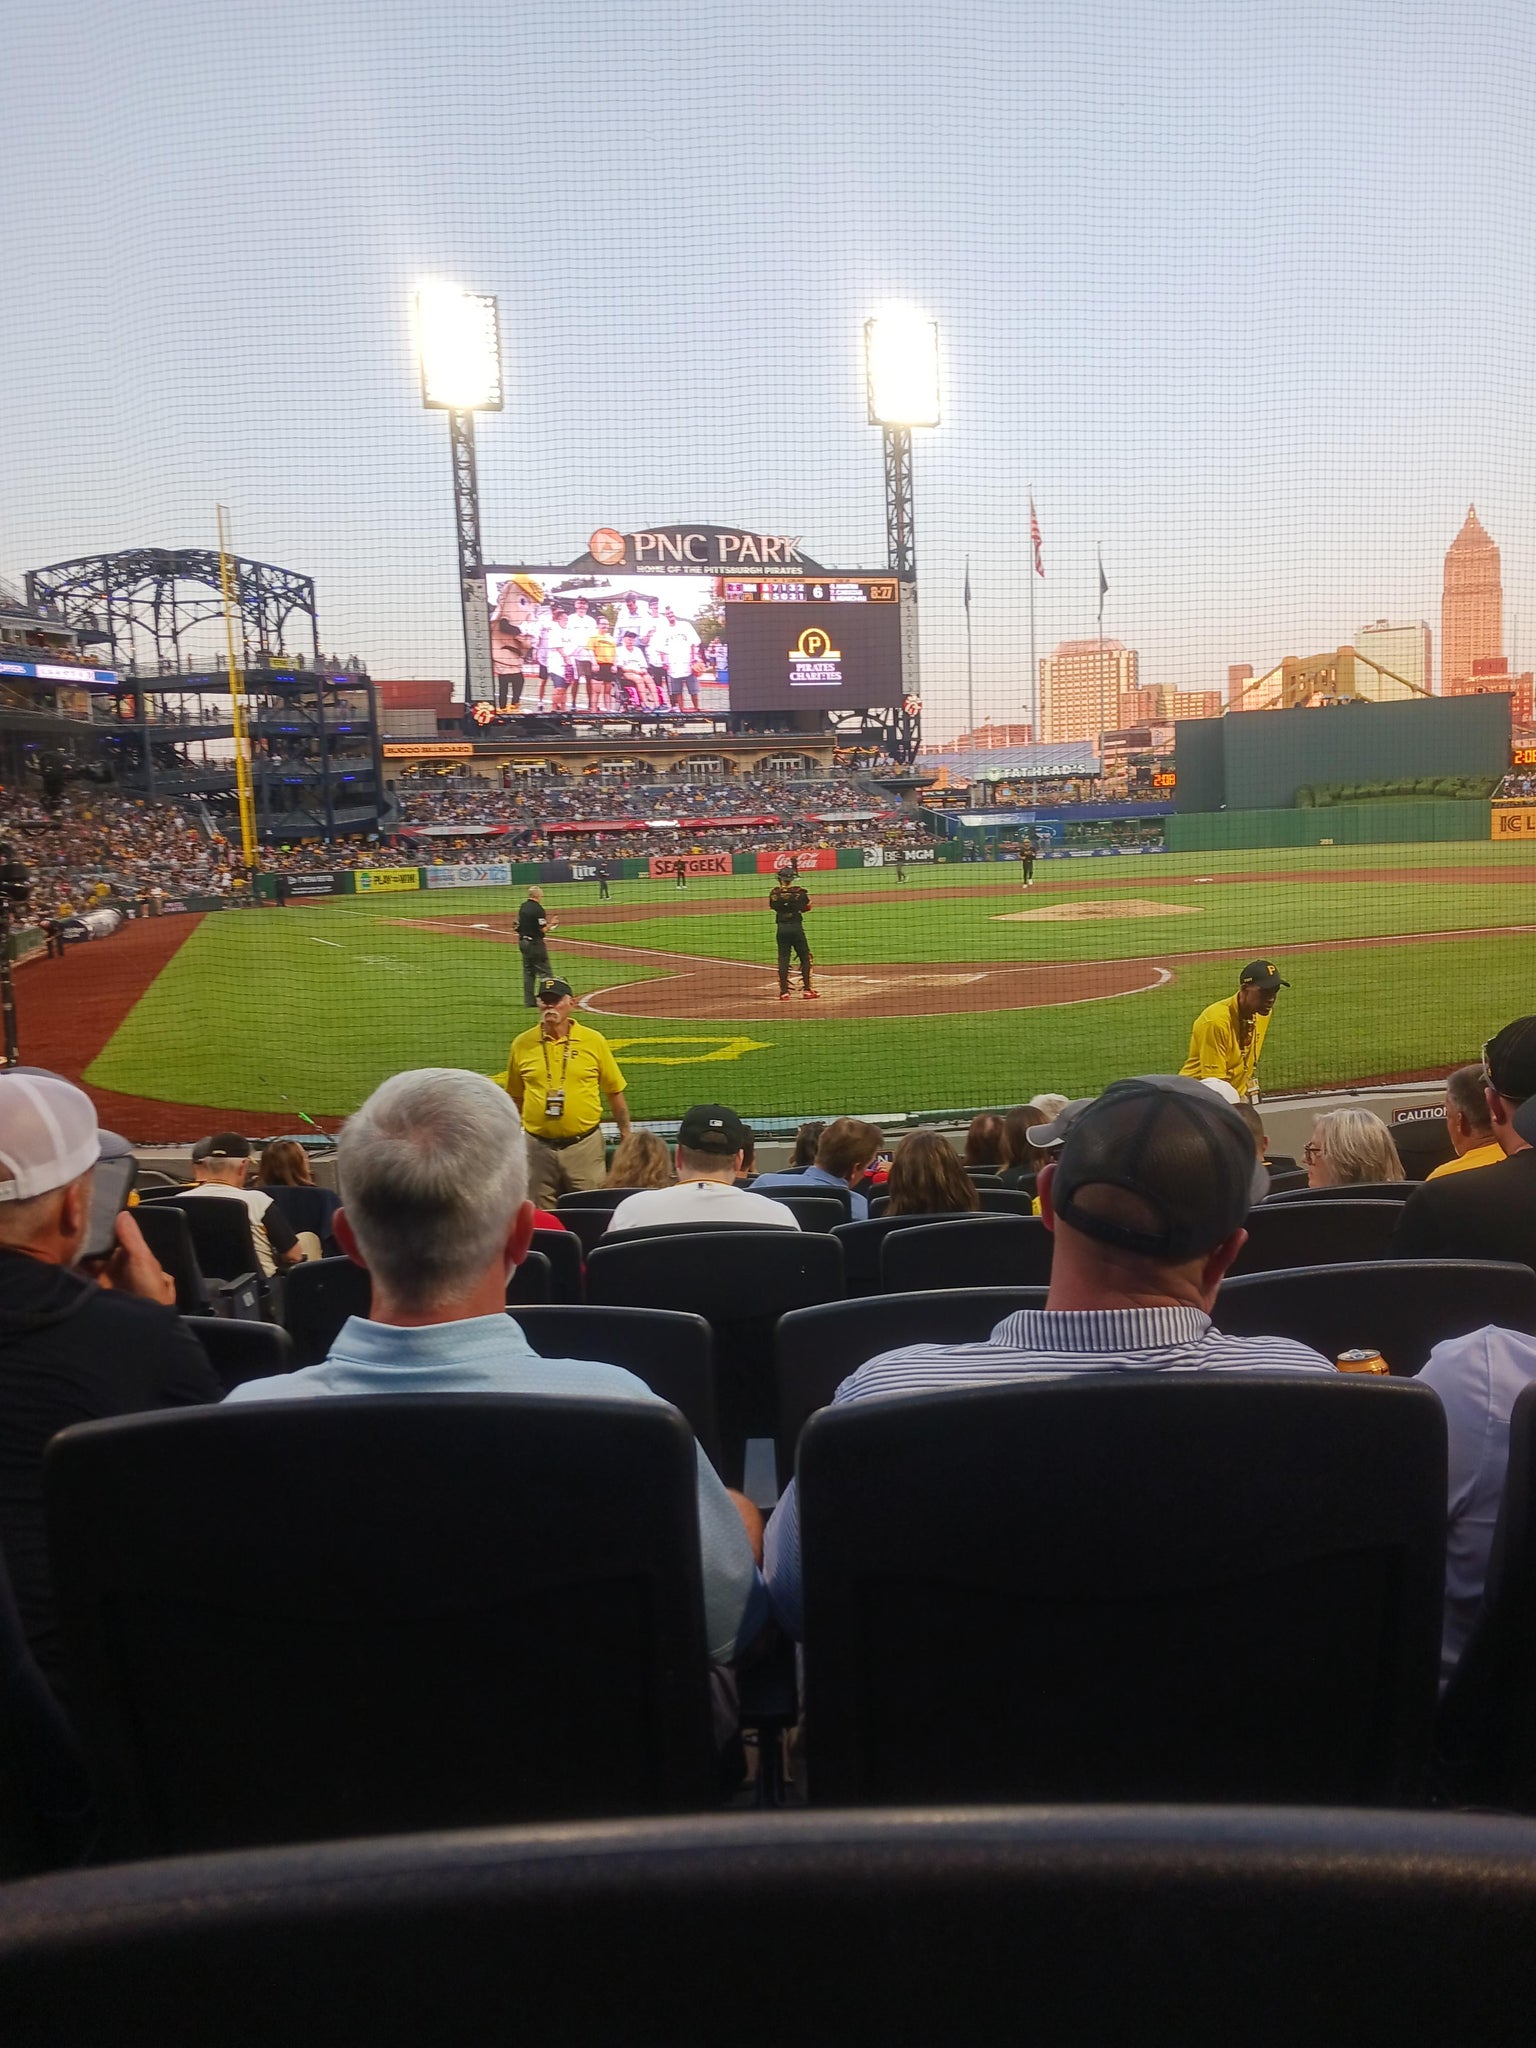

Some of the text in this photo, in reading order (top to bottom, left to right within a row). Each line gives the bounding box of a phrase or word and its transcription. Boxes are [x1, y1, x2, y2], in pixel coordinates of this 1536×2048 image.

[630, 533, 804, 564] PNC PARK
[636, 565, 804, 575] HOME OF THE PITTSBURGH PIRATES
[812, 586, 823, 599] 6
[808, 636, 822, 654] P
[795, 663, 836, 672] PIRATES
[789, 671, 843, 681] CHARITIES
[1003, 767, 1031, 778] FAT
[1266, 965, 1276, 976] P
[545, 980, 555, 989] P
